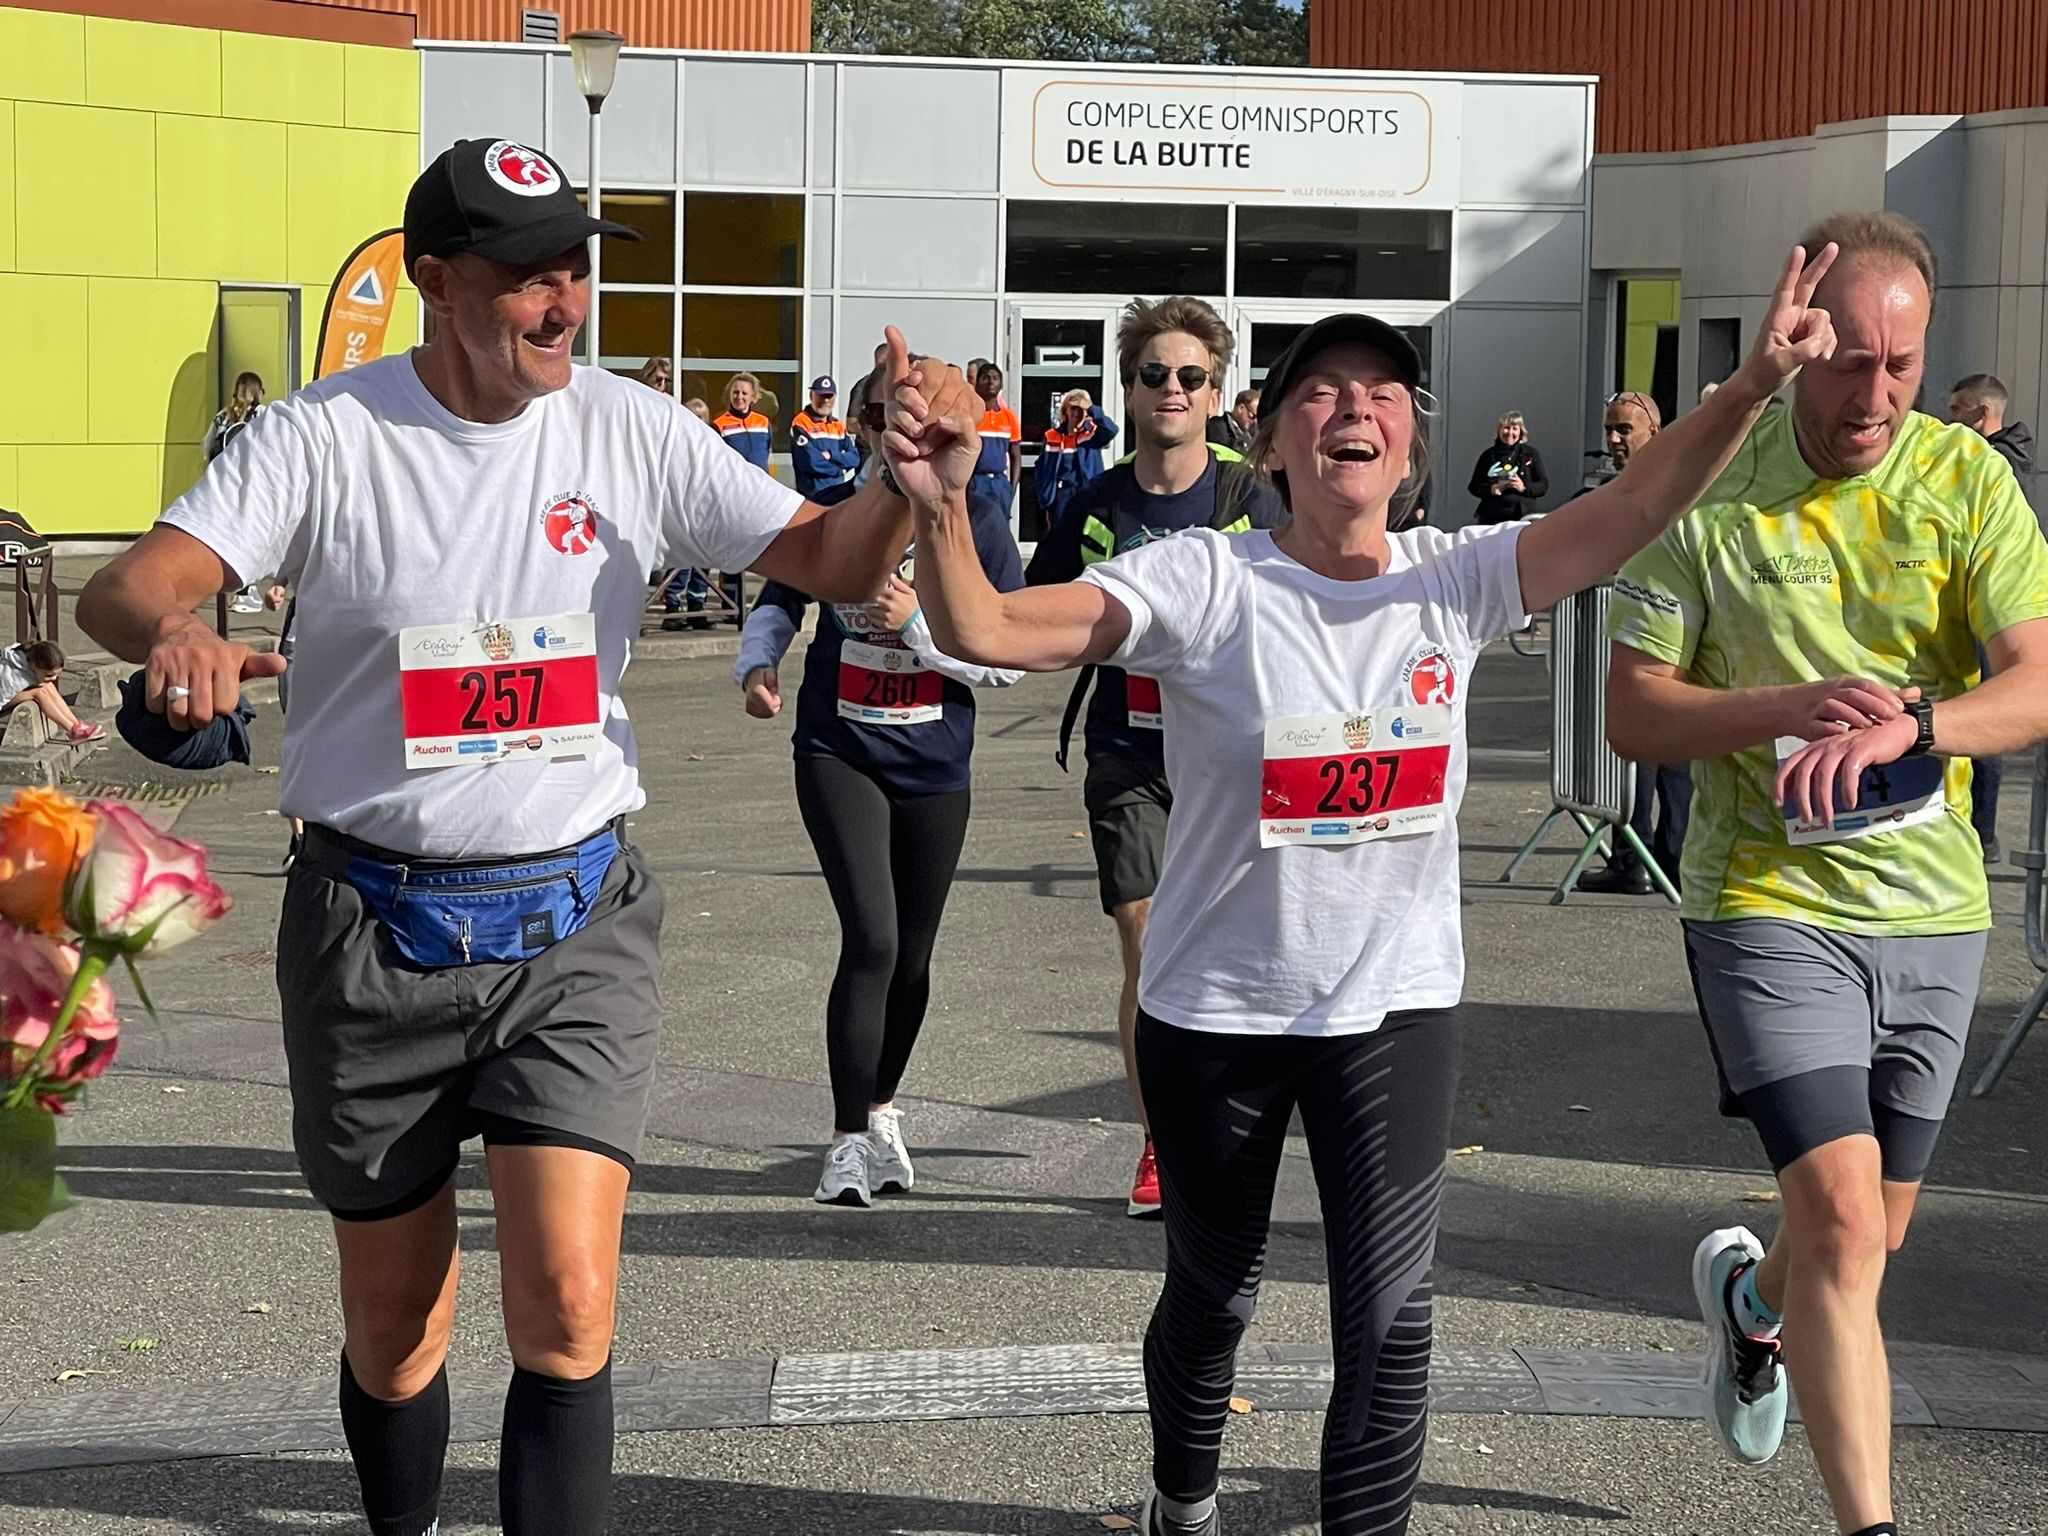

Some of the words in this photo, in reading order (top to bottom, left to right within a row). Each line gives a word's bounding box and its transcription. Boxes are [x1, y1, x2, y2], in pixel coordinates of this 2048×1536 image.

[1066, 101, 1213, 131] COMPLEXE
[1221, 105, 1399, 135] OMNISPORTS
[1066, 139, 1103, 165] DE
[1113, 140, 1148, 167] LA
[1157, 142, 1250, 169] BUTTE
[1292, 188, 1314, 196] VILLE
[1895, 560, 1926, 570] TACTIC
[1751, 574, 1817, 585] MENUCOURT
[1820, 574, 1832, 584] 95
[460, 667, 544, 731] 257
[864, 672, 917, 707] 260
[560, 733, 594, 743] SAFRAN
[413, 745, 452, 755] Auchan
[1317, 755, 1400, 815] 237
[1868, 766, 1891, 802] 4
[1268, 825, 1305, 835] Auchan
